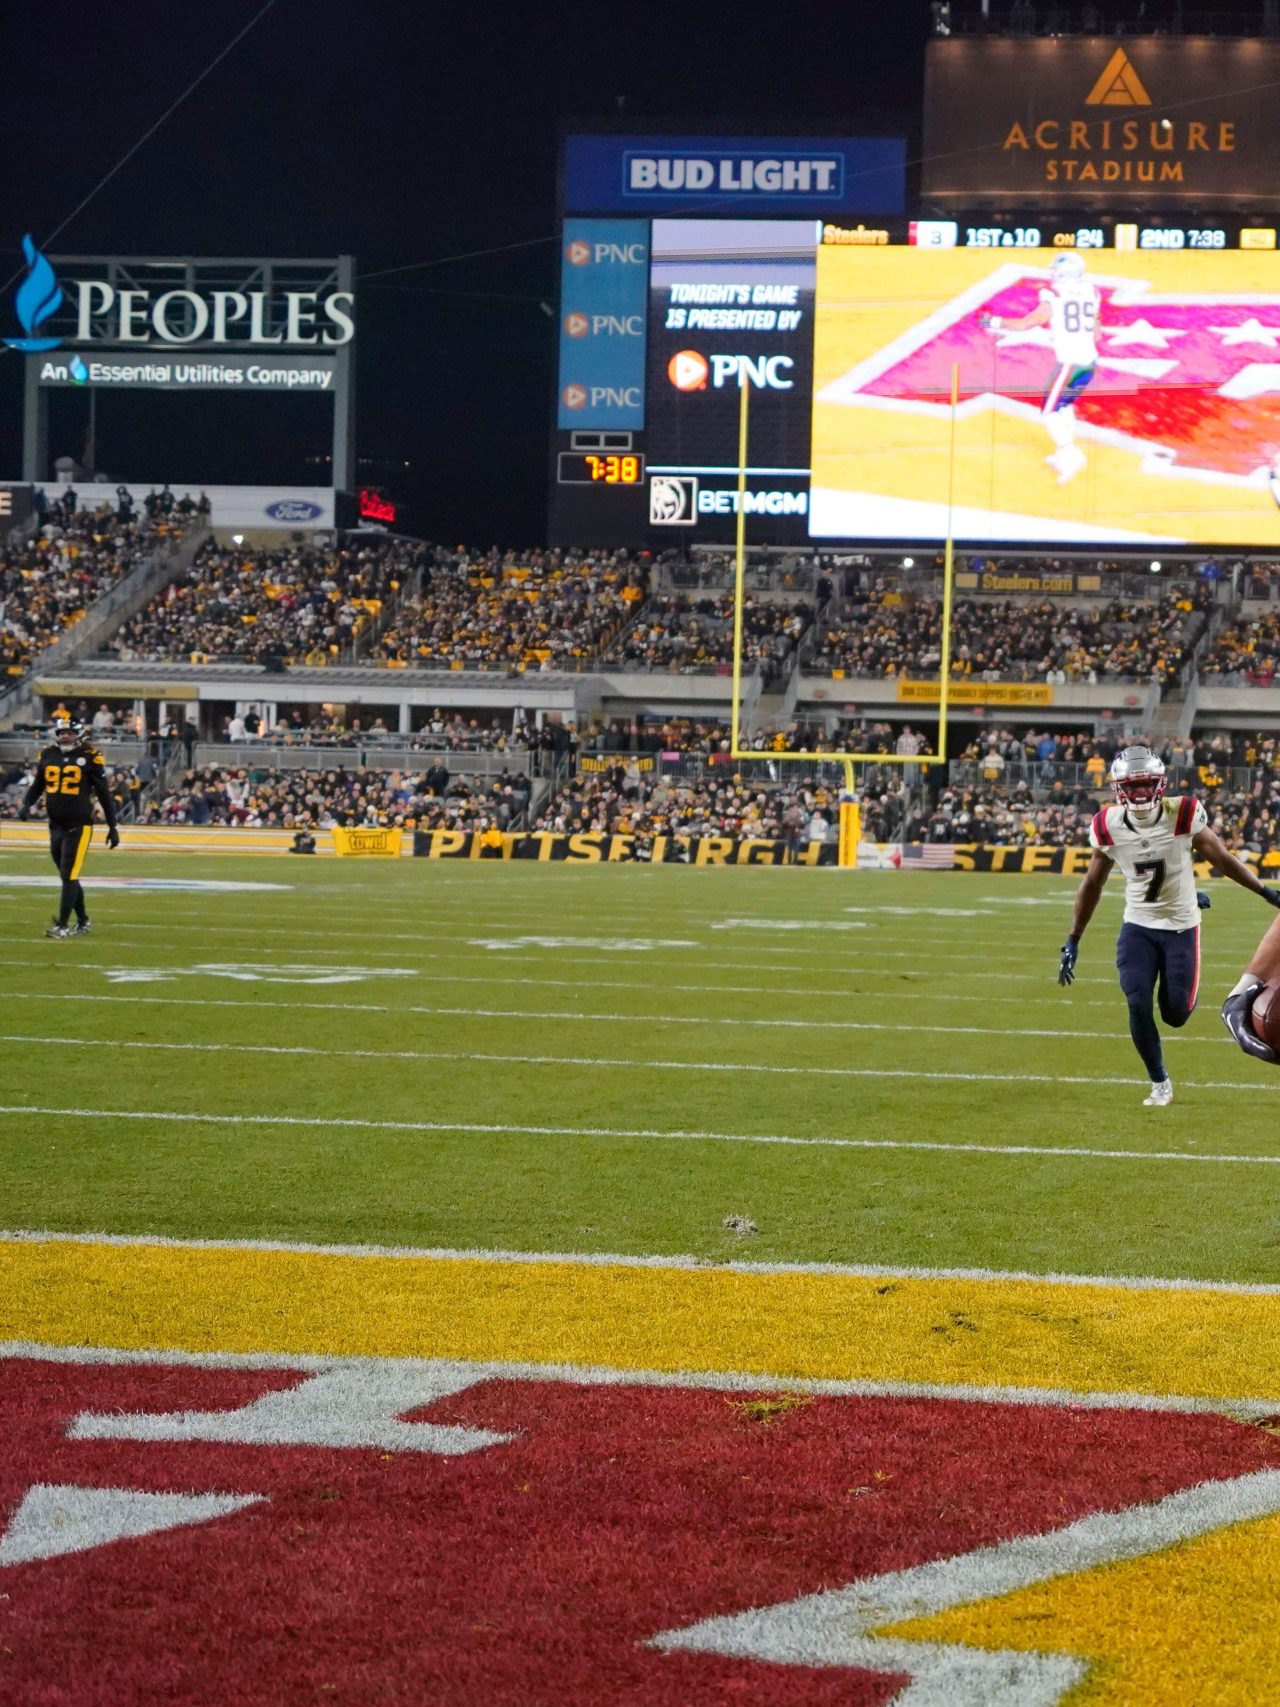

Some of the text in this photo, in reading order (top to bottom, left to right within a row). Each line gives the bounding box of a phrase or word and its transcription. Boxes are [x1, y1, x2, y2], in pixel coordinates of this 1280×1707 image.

[1003, 120, 1235, 151] ACRISURE
[630, 158, 836, 191] BUD LIGHT
[1045, 160, 1184, 182] STADIUM
[1054, 229, 1104, 248] ON 24
[1140, 229, 1226, 249] 2ND 7:38
[594, 243, 645, 266] PNC
[670, 284, 799, 304] TONIGHT'S GAME
[75, 280, 355, 346] PEOPLES
[665, 309, 802, 331] IS PRESENTED BY
[1063, 300, 1096, 333] 85
[592, 315, 643, 337] PNC
[41, 363, 332, 389] An Essential Utilities Company
[709, 354, 795, 389] PNC
[590, 387, 641, 408] PNC
[585, 456, 638, 484] 7:38
[275, 501, 313, 521] Ford
[698, 490, 808, 514] BETMGM
[982, 573, 1073, 592] Steelers.com
[44, 765, 83, 795] 92
[1133, 858, 1167, 904] 7
